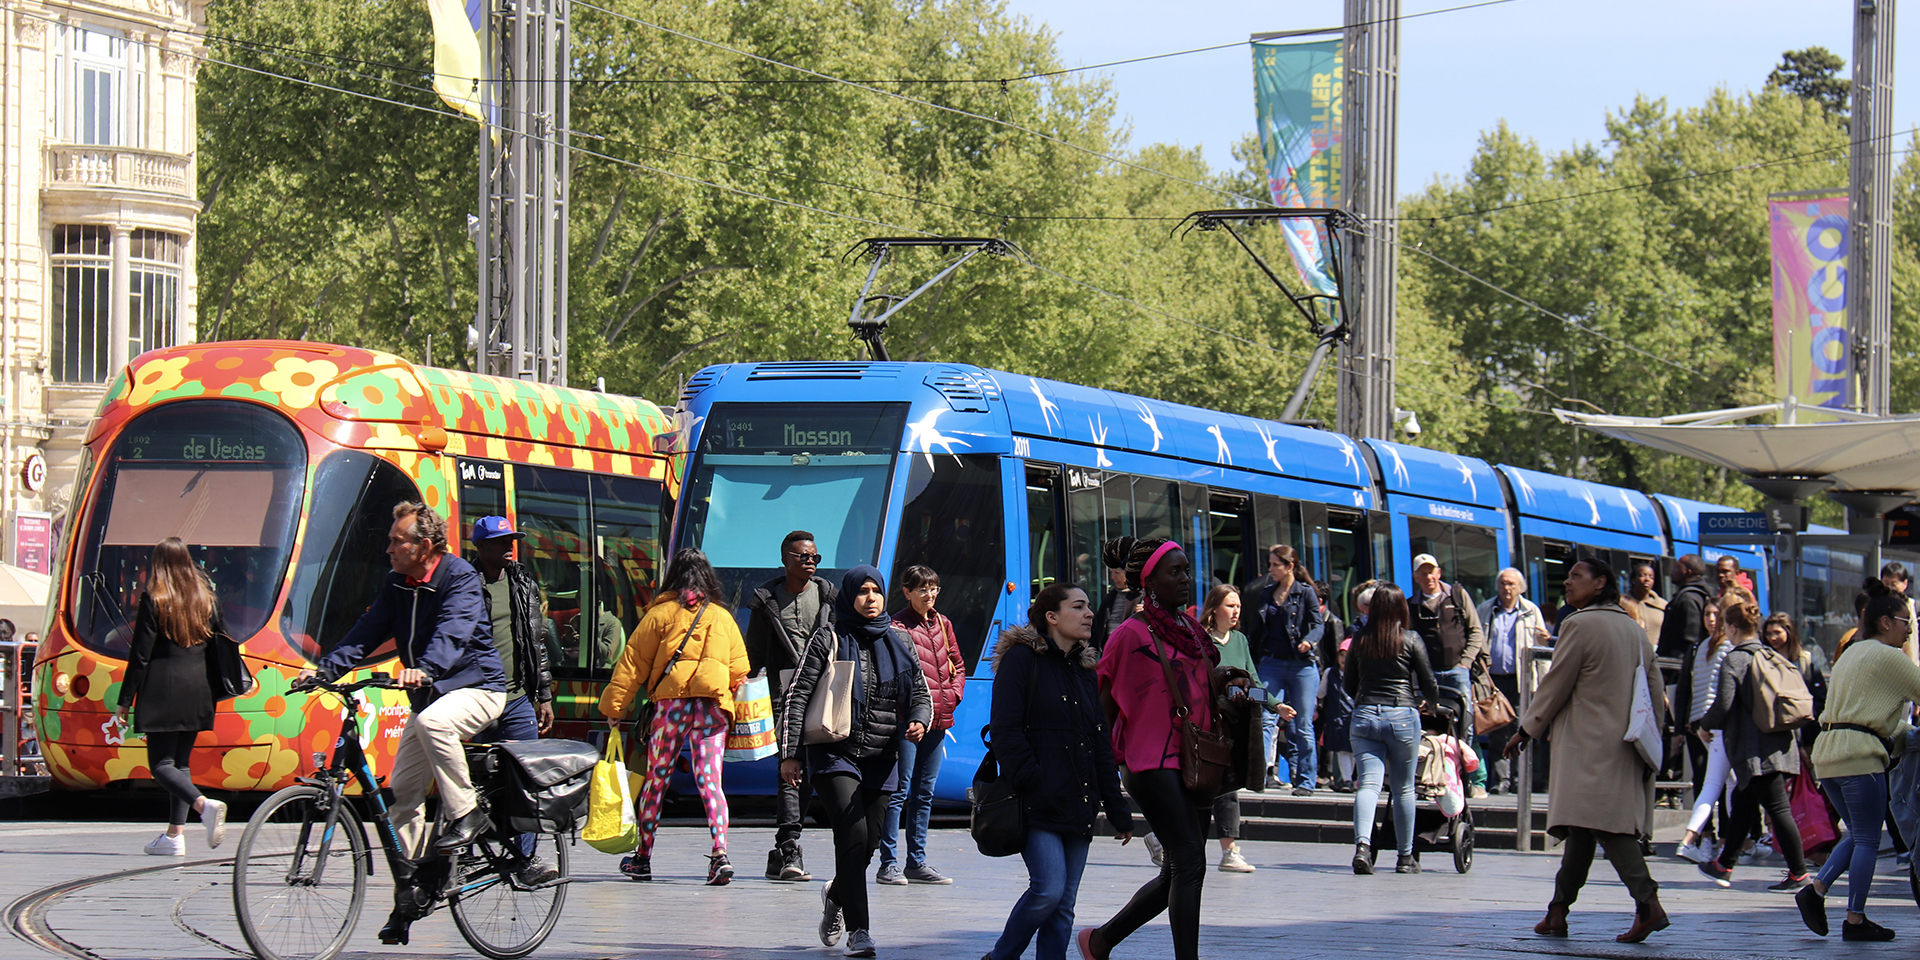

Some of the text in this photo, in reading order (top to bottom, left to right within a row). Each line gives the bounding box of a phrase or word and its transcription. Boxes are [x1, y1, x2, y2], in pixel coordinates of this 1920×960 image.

[731, 422, 753, 431] 2401
[128, 436, 150, 444] 1802
[784, 423, 852, 446] Mosson
[737, 436, 745, 447] 1
[1013, 436, 1030, 457] 2011
[133, 447, 143, 459] 2
[183, 437, 206, 460] de
[32, 463, 42, 482] G
[1708, 517, 1766, 529] COMEDIE
[735, 722, 761, 734] PORTER
[729, 735, 763, 748] COURSES
